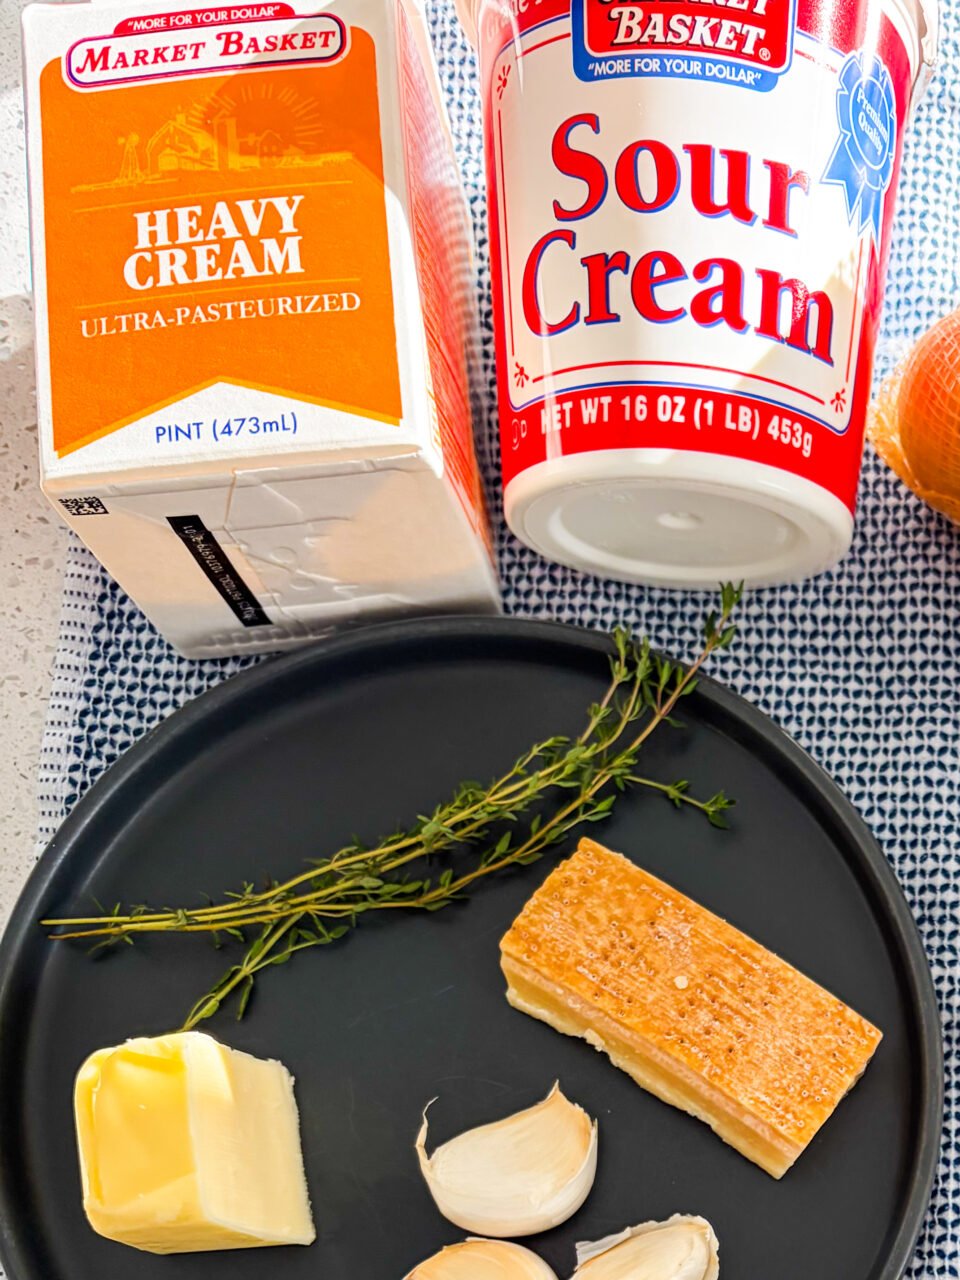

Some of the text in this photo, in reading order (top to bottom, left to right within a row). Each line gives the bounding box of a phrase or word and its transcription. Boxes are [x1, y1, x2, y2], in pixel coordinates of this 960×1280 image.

[169, 15, 193, 27] FOR
[196, 11, 228, 23] YOUR
[75, 30, 337, 74] MARKET BASKET
[634, 58, 659, 73] FOR
[661, 58, 702, 76] YOUR
[856, 86, 889, 144] Premium
[857, 111, 884, 156] Quality
[551, 112, 811, 239] Sour
[132, 195, 305, 250] HEAVY
[123, 235, 305, 291] CREAM
[80, 291, 361, 339] ULTRA-PASTEURIZED
[521, 229, 835, 368] Cream
[155, 411, 298, 444] PINT (473mL)
[540, 401, 573, 436] NET
[580, 395, 613, 425] WT
[620, 394, 648, 422] 16
[656, 395, 686, 423] OZ
[693, 397, 715, 431] (1
[724, 402, 761, 441] LB)
[766, 415, 813, 458] 453g
